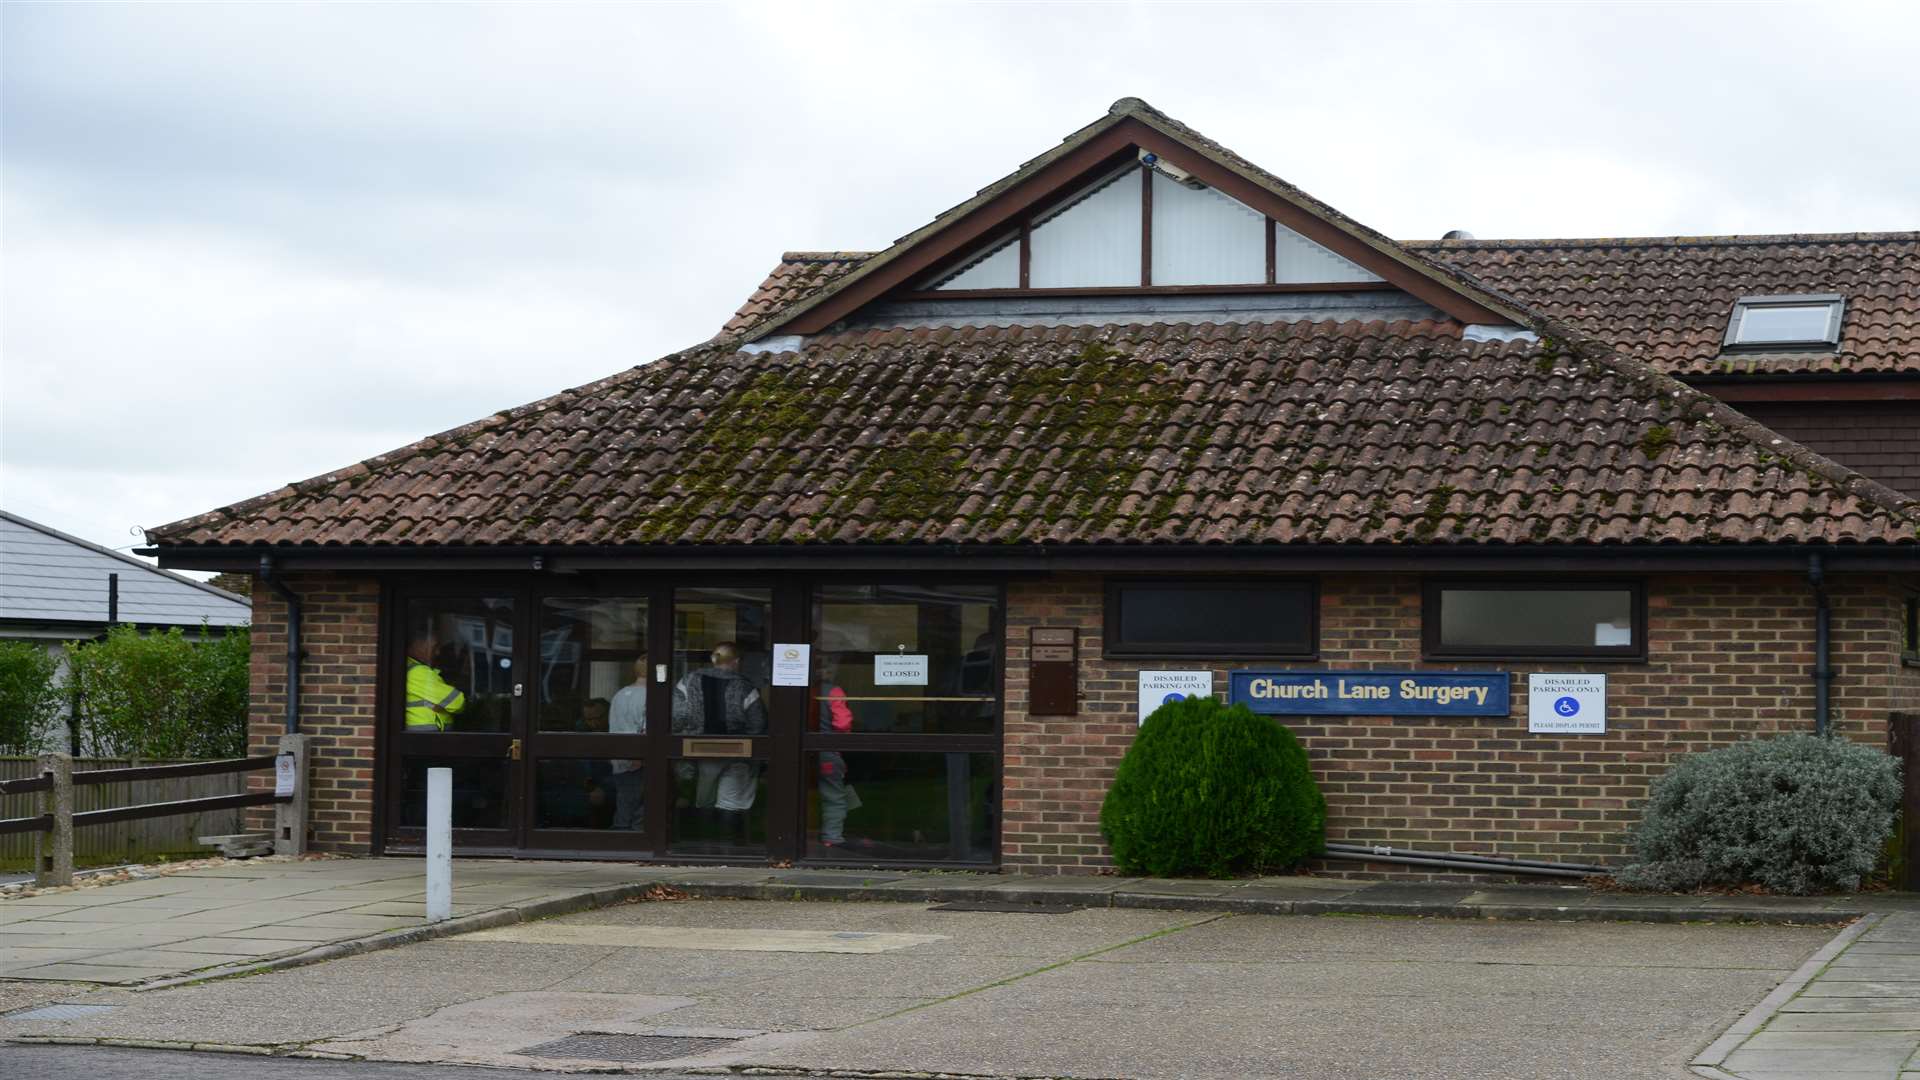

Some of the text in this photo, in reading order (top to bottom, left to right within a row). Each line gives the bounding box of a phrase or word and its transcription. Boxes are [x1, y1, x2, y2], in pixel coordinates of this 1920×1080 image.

[882, 670, 920, 678] CLOSED
[1249, 678, 1489, 705] Church Lane Surgery
